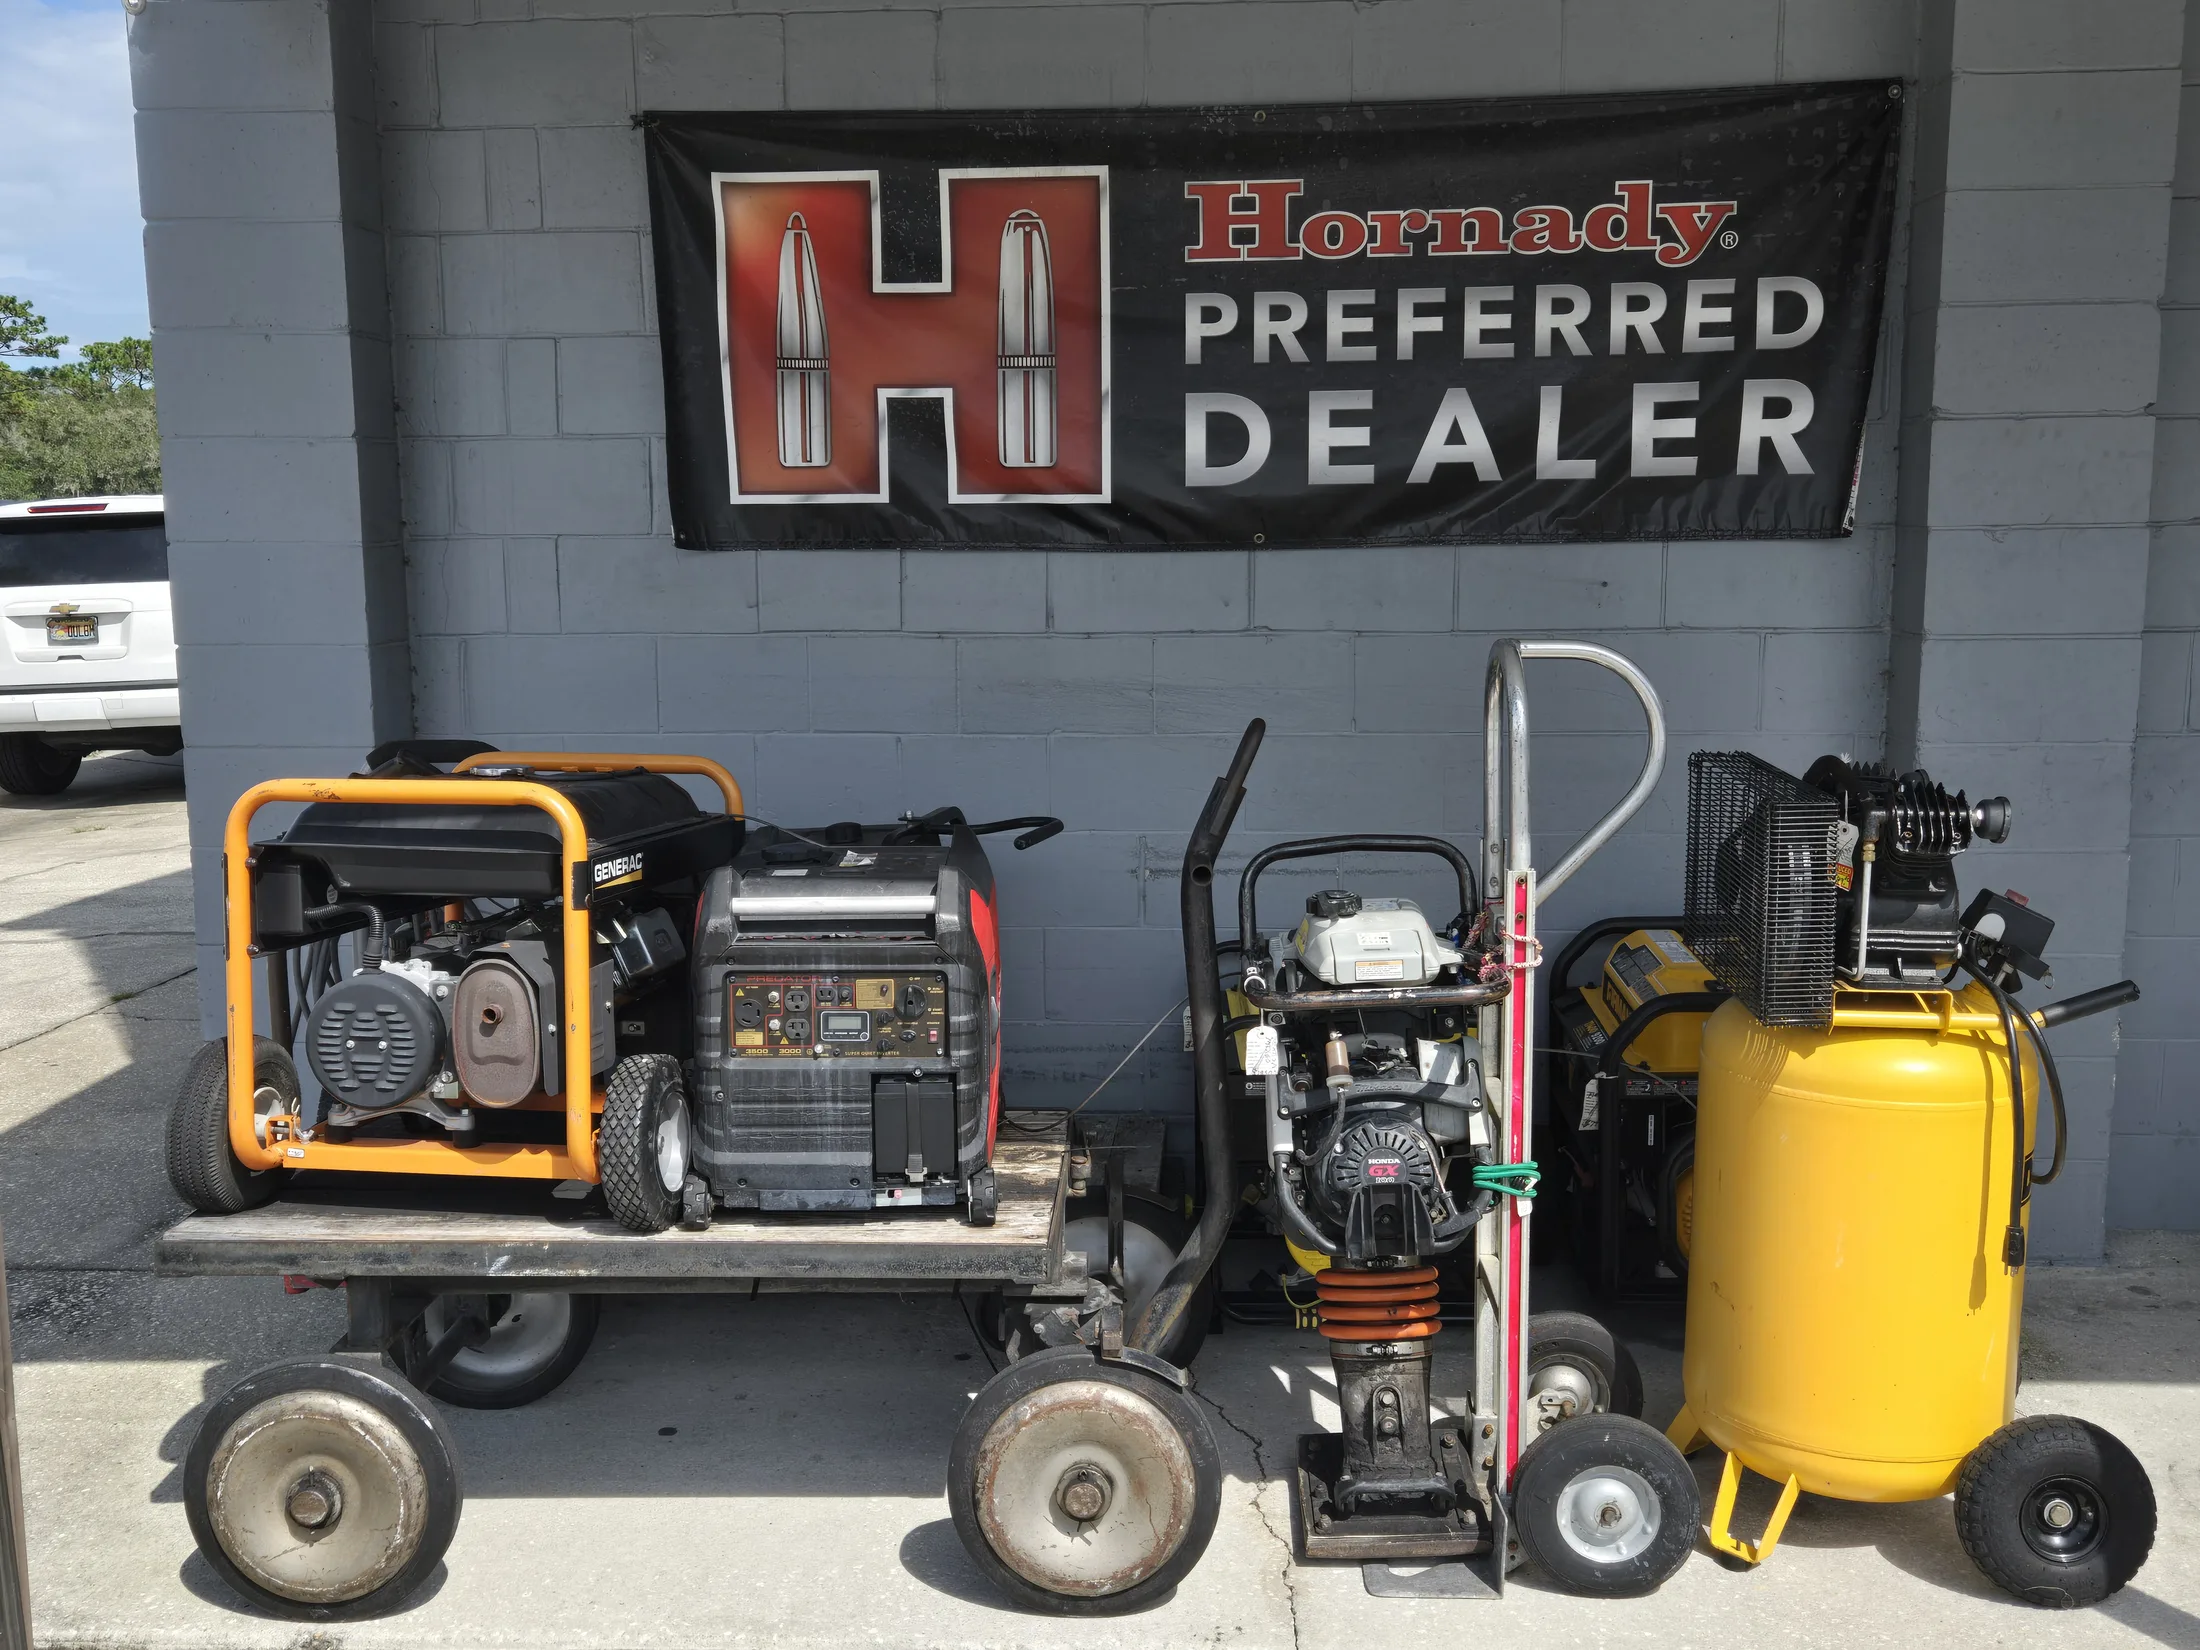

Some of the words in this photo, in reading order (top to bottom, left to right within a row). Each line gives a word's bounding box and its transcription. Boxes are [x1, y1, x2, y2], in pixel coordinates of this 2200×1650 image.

[1184, 276, 1825, 365] PREFERRED
[1184, 379, 1816, 488] DEALER
[594, 852, 643, 882] GENERAC
[1368, 1165, 1400, 1177] GX
[1375, 1176, 1396, 1184] 100
